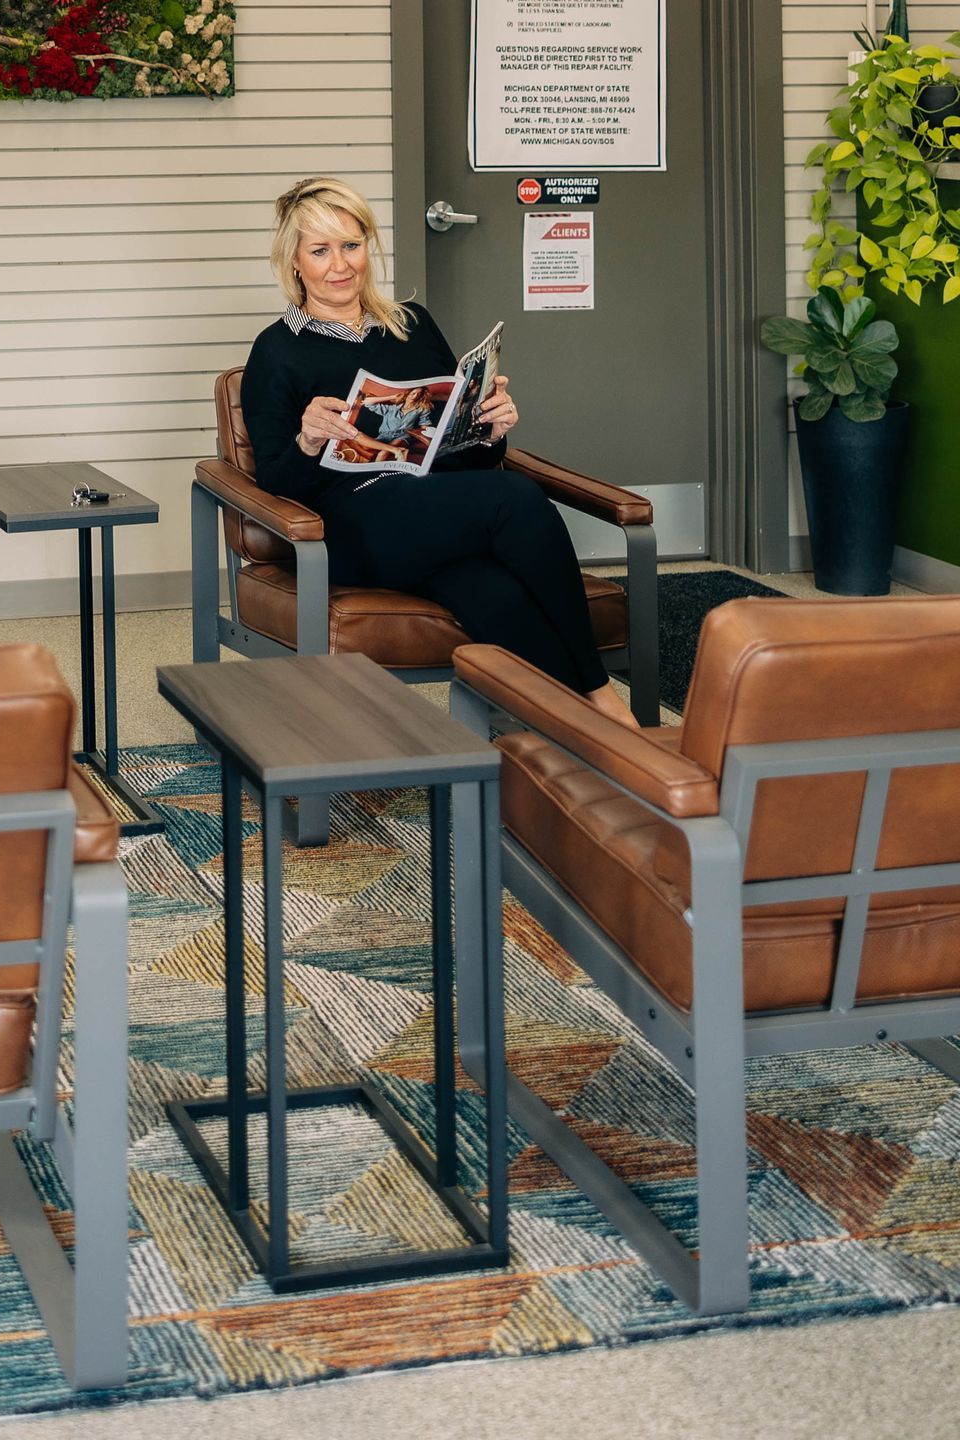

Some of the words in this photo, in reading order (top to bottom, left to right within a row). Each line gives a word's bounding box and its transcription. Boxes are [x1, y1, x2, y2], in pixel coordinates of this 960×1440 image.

[565, 96, 598, 104] LANSING,
[505, 127, 556, 135] DEPARTMENT
[559, 127, 568, 135] OF
[570, 127, 593, 135] STATE
[595, 127, 630, 135] WEBSITE:
[545, 178, 598, 186] AUTHORIZED
[520, 187, 539, 195] STOP
[547, 187, 597, 195] PERSONNEL
[560, 196, 583, 204] ONLY
[551, 228, 587, 237] CLIENTS
